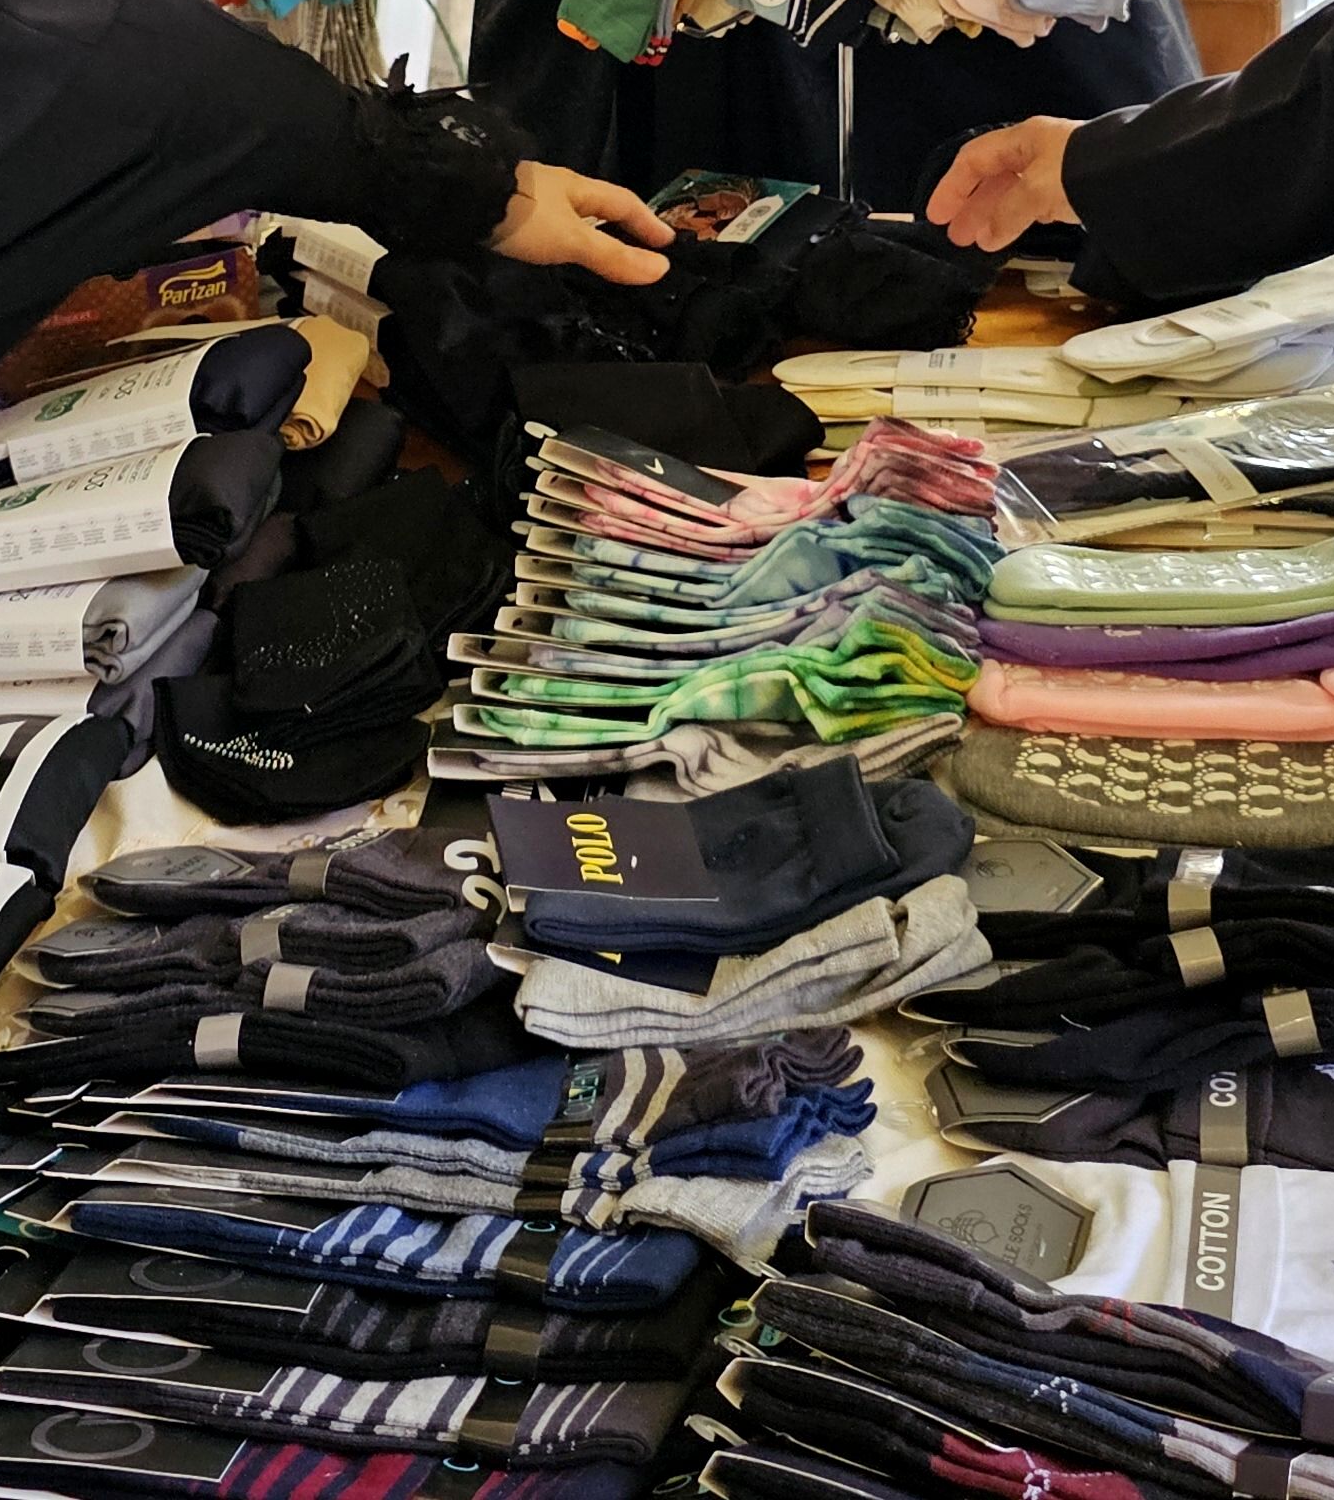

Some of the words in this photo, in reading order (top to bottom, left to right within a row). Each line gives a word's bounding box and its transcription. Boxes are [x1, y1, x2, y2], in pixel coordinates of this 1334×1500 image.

[159, 278, 228, 308] Parizan
[566, 813, 624, 885] POLO
[1194, 1191, 1231, 1293] COTTON
